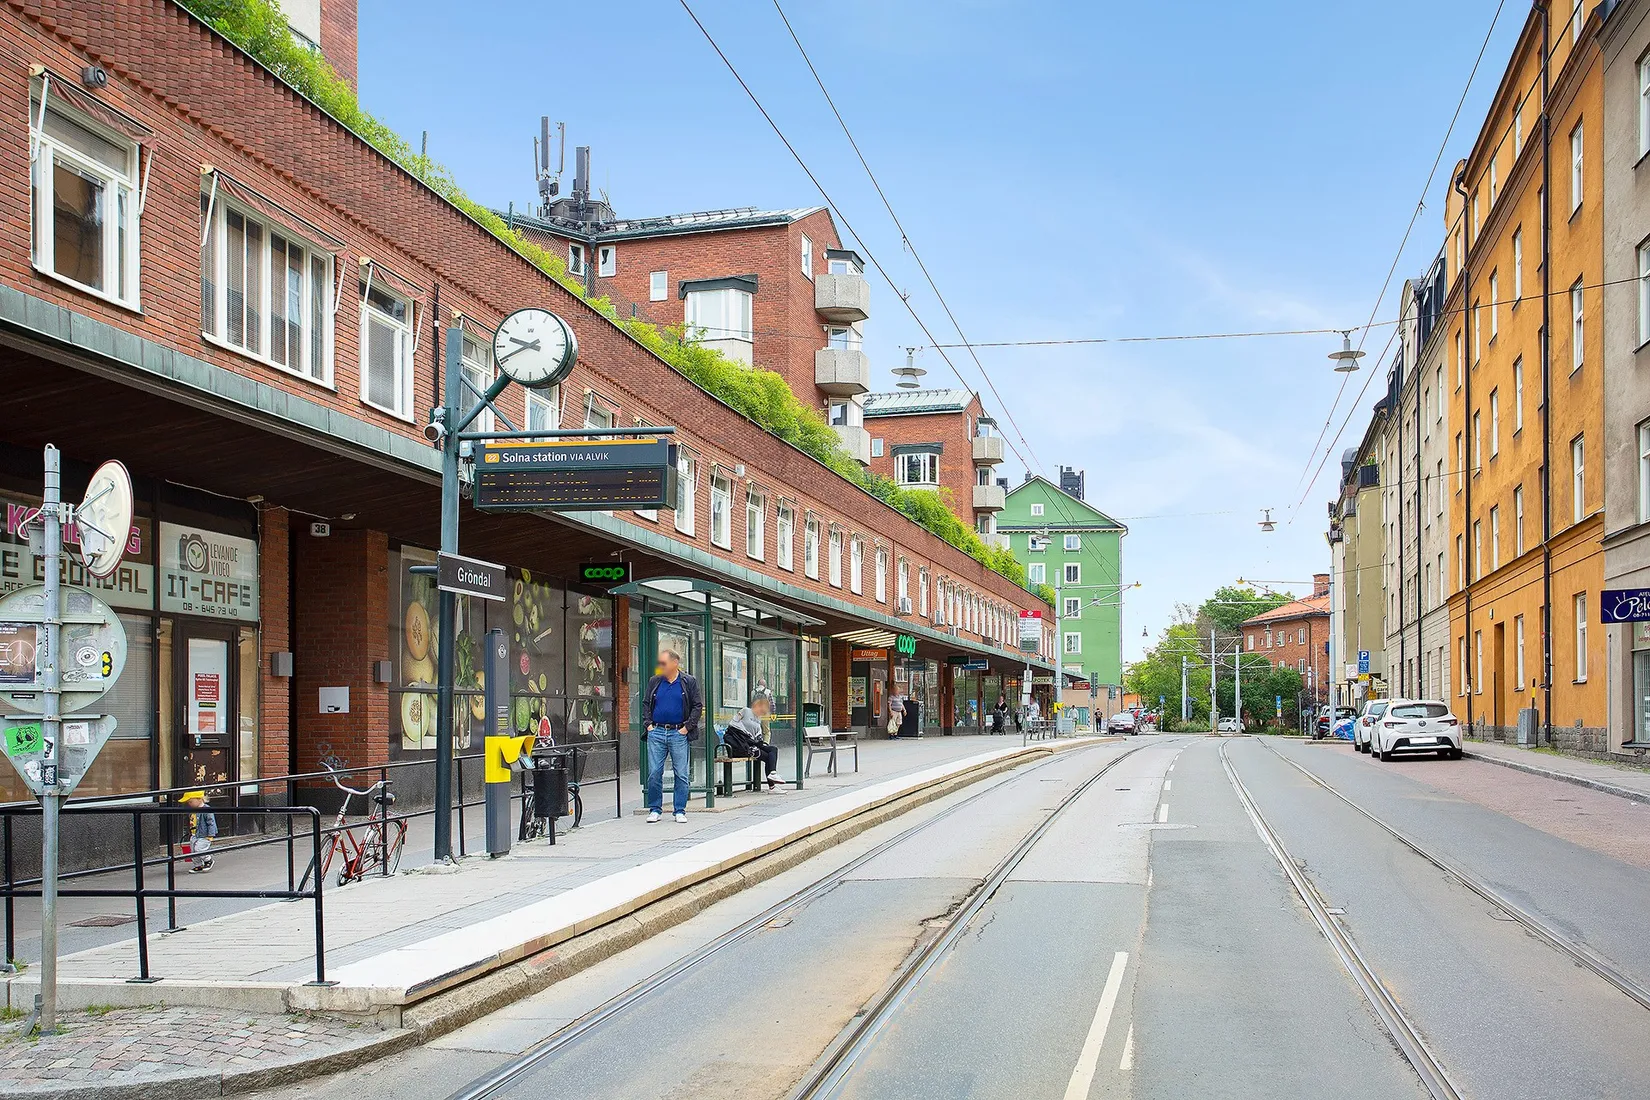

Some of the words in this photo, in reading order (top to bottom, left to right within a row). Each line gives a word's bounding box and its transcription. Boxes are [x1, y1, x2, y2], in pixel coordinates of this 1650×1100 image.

[502, 452, 531, 463] Solna
[532, 451, 567, 462] station
[569, 452, 584, 461] VIA
[585, 452, 609, 461] ALVIK
[315, 524, 326, 534] 38
[210, 543, 238, 563] LEVANDE
[211, 560, 230, 577] VIDEO
[584, 567, 625, 580] coop
[457, 566, 491, 588] Gröndal
[167, 573, 250, 607] IT-CAFE
[183, 602, 192, 611] 08
[201, 604, 215, 613] 645
[228, 608, 238, 616] 40
[898, 634, 916, 659] coop
[1360, 651, 1367, 660] P
